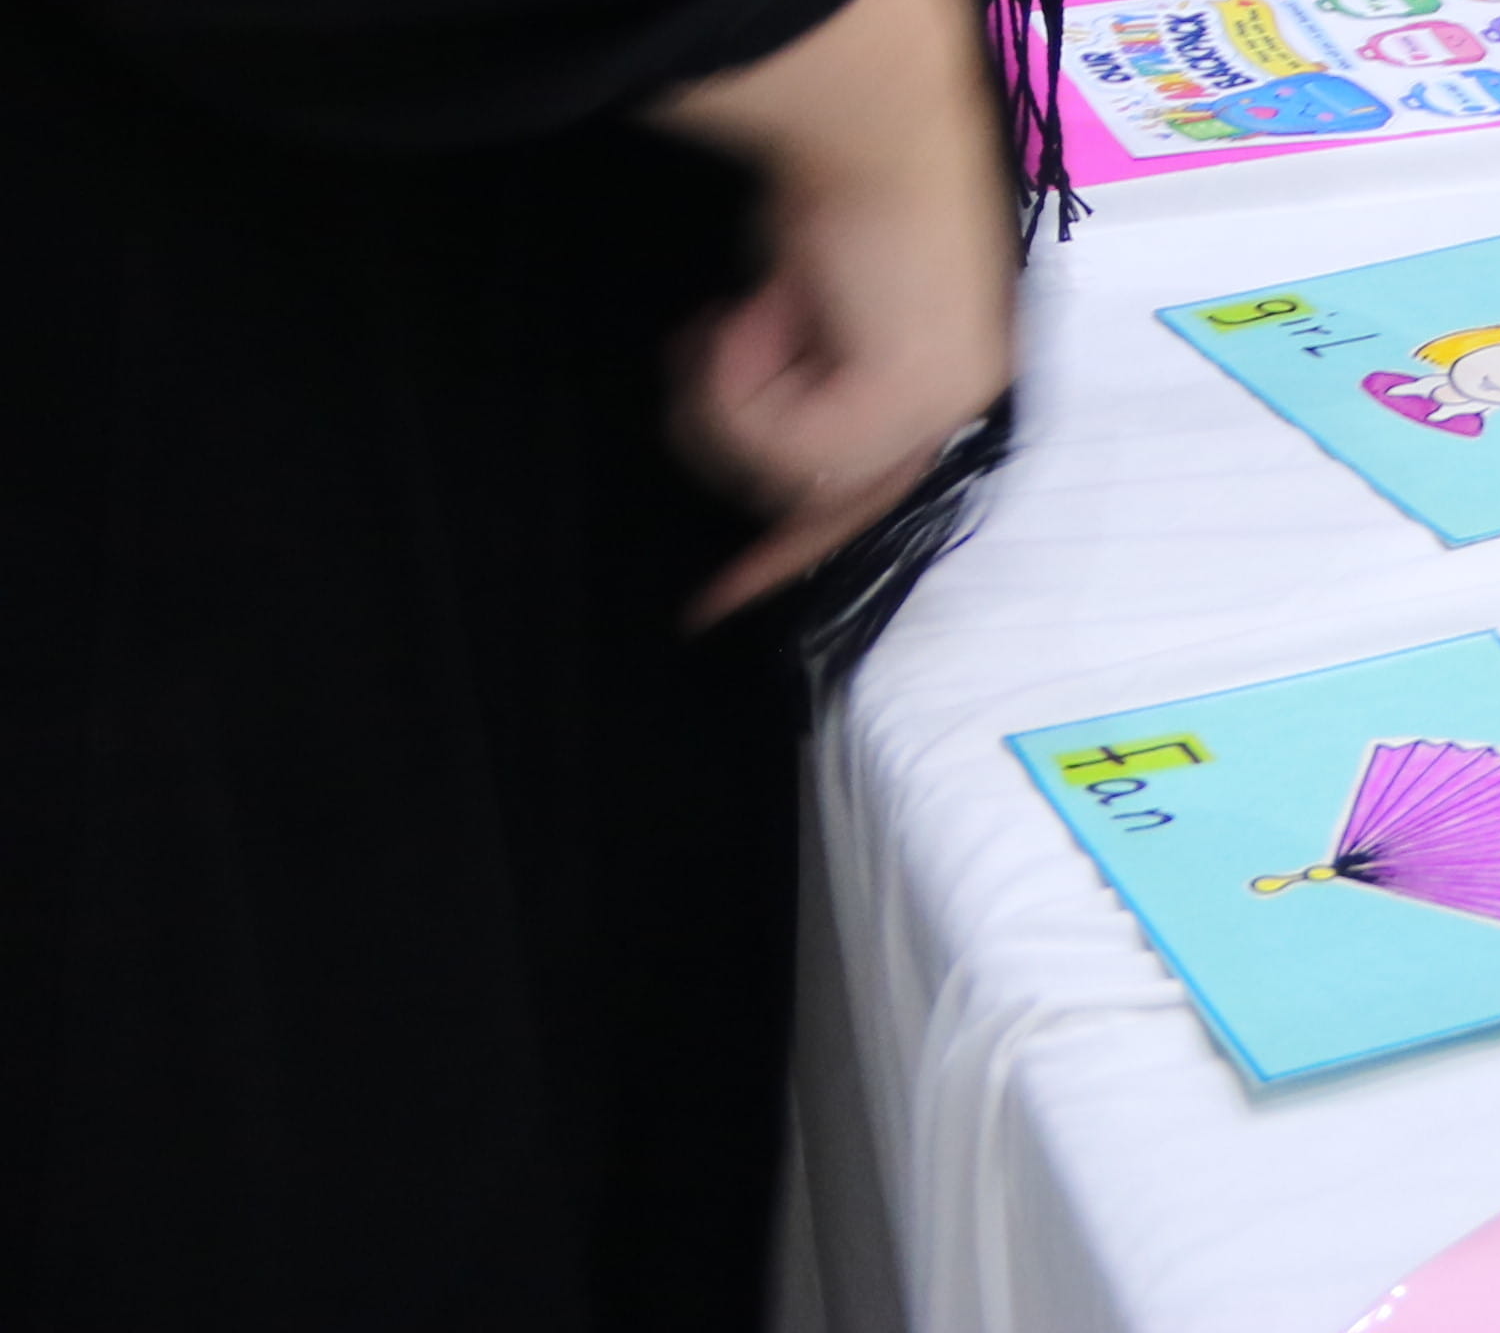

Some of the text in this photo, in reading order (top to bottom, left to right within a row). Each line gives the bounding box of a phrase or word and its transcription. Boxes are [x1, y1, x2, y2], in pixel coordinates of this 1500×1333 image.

[1081, 51, 1133, 83] OUR
[1163, 10, 1256, 89] BACKPACK
[1206, 298, 1381, 358] girl
[1063, 741, 1203, 833] fan
